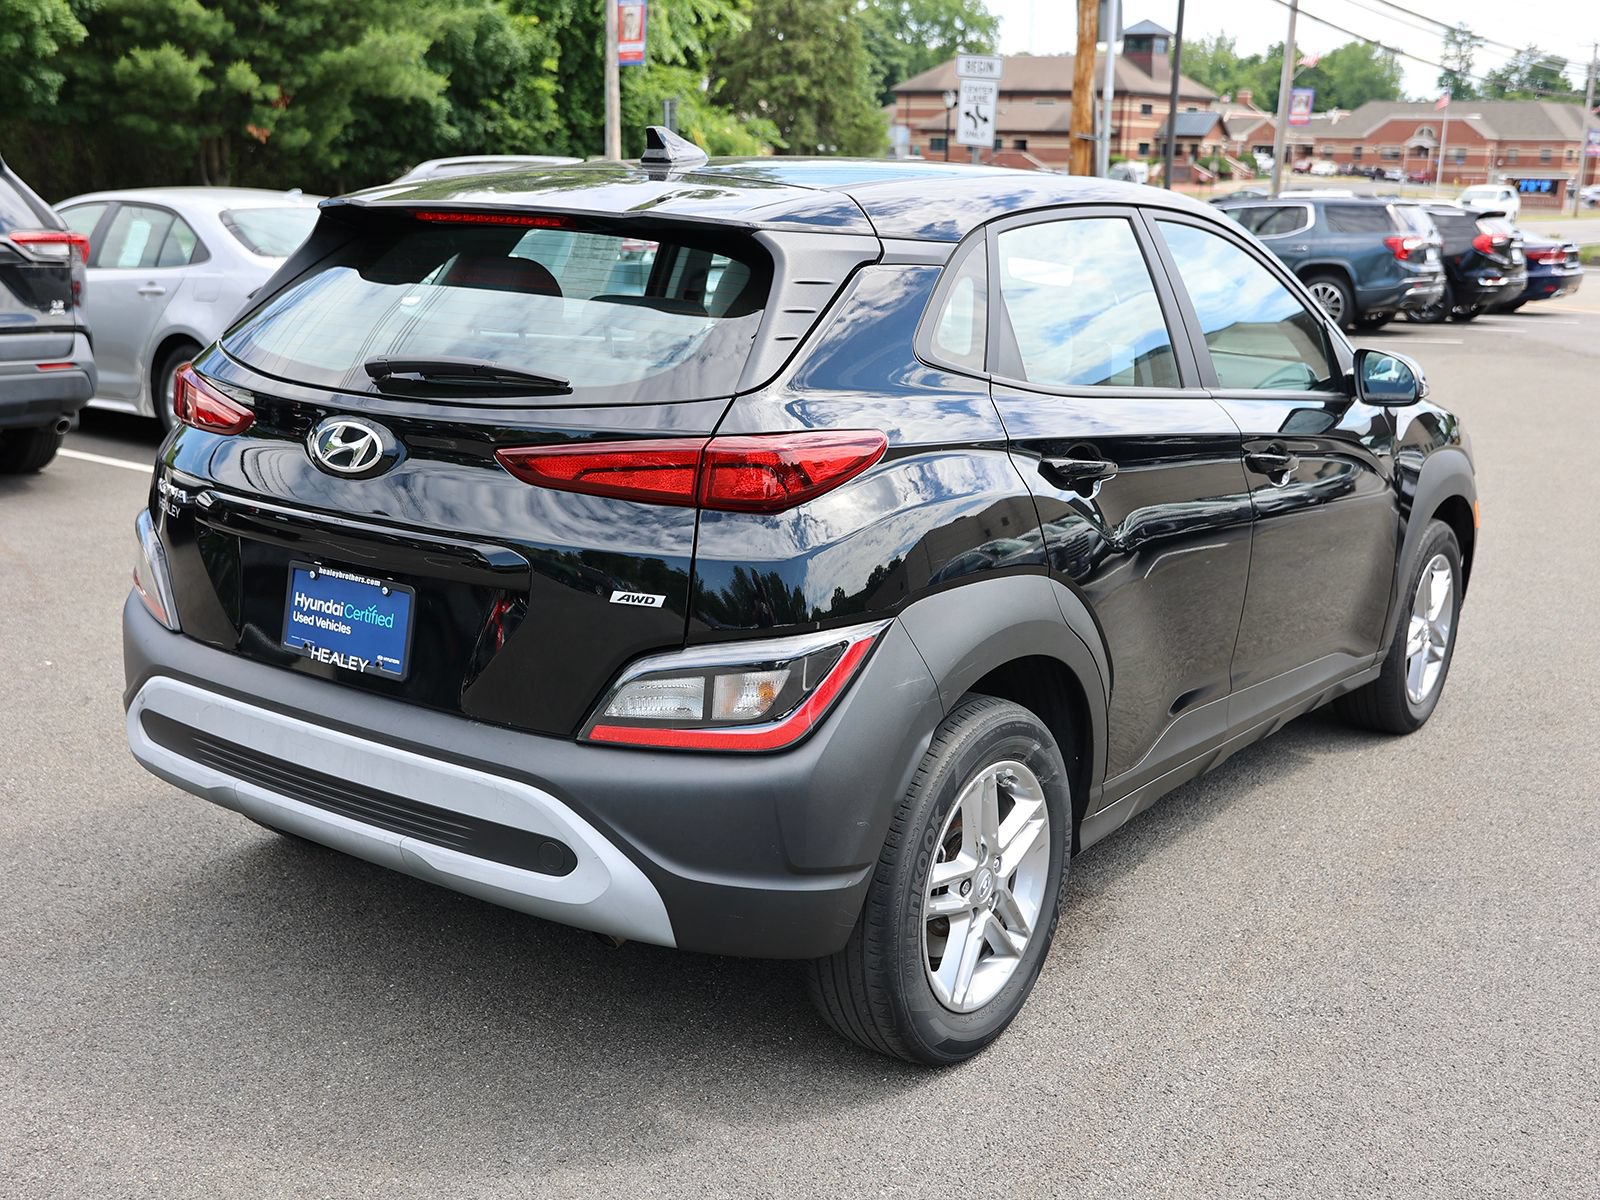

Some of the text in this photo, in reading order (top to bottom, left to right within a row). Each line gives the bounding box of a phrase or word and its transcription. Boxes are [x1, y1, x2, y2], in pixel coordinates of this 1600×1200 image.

[965, 60, 994, 73] BEGIN
[967, 94, 989, 103] LANE
[318, 566, 381, 587] healeybrothers.com
[294, 591, 394, 628] Hyundai Certified
[617, 594, 656, 605] AWD
[293, 610, 352, 635] Used Vehicles
[310, 645, 369, 673] HEALEY
